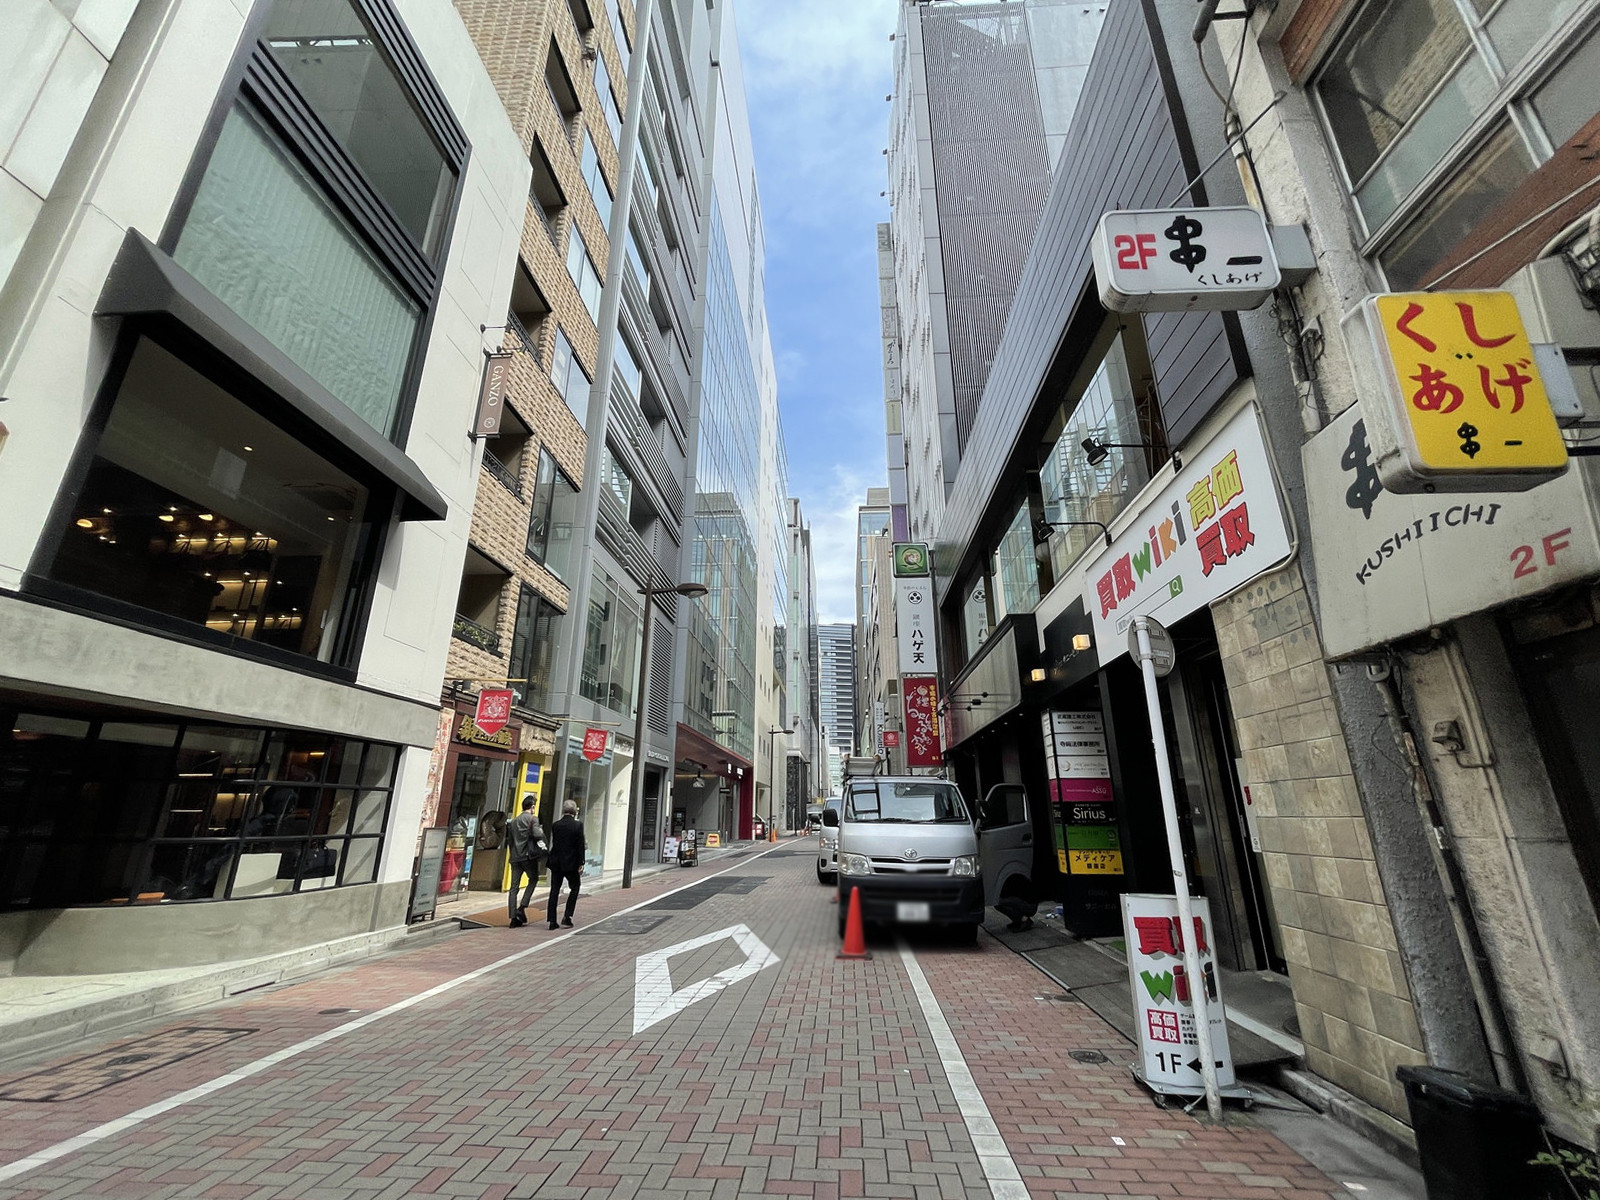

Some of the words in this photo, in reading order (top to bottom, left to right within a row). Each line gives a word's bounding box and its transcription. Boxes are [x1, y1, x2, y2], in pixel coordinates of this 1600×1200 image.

[1114, 233, 1157, 270] 2F
[1197, 271, 1263, 285] くしあげ
[1396, 302, 1516, 353] くし
[487, 365, 504, 407] GANZO
[1408, 358, 1533, 414] あげ
[1185, 448, 1244, 531] 高価
[1195, 501, 1256, 578] 買取
[1509, 527, 1572, 579] 2F
[1073, 807, 1107, 820] Sirius
[1075, 854, 1116, 862] メディケア
[1150, 1011, 1176, 1027] 高価
[1152, 1026, 1179, 1043] 買取
[1155, 1051, 1182, 1074] 1F
